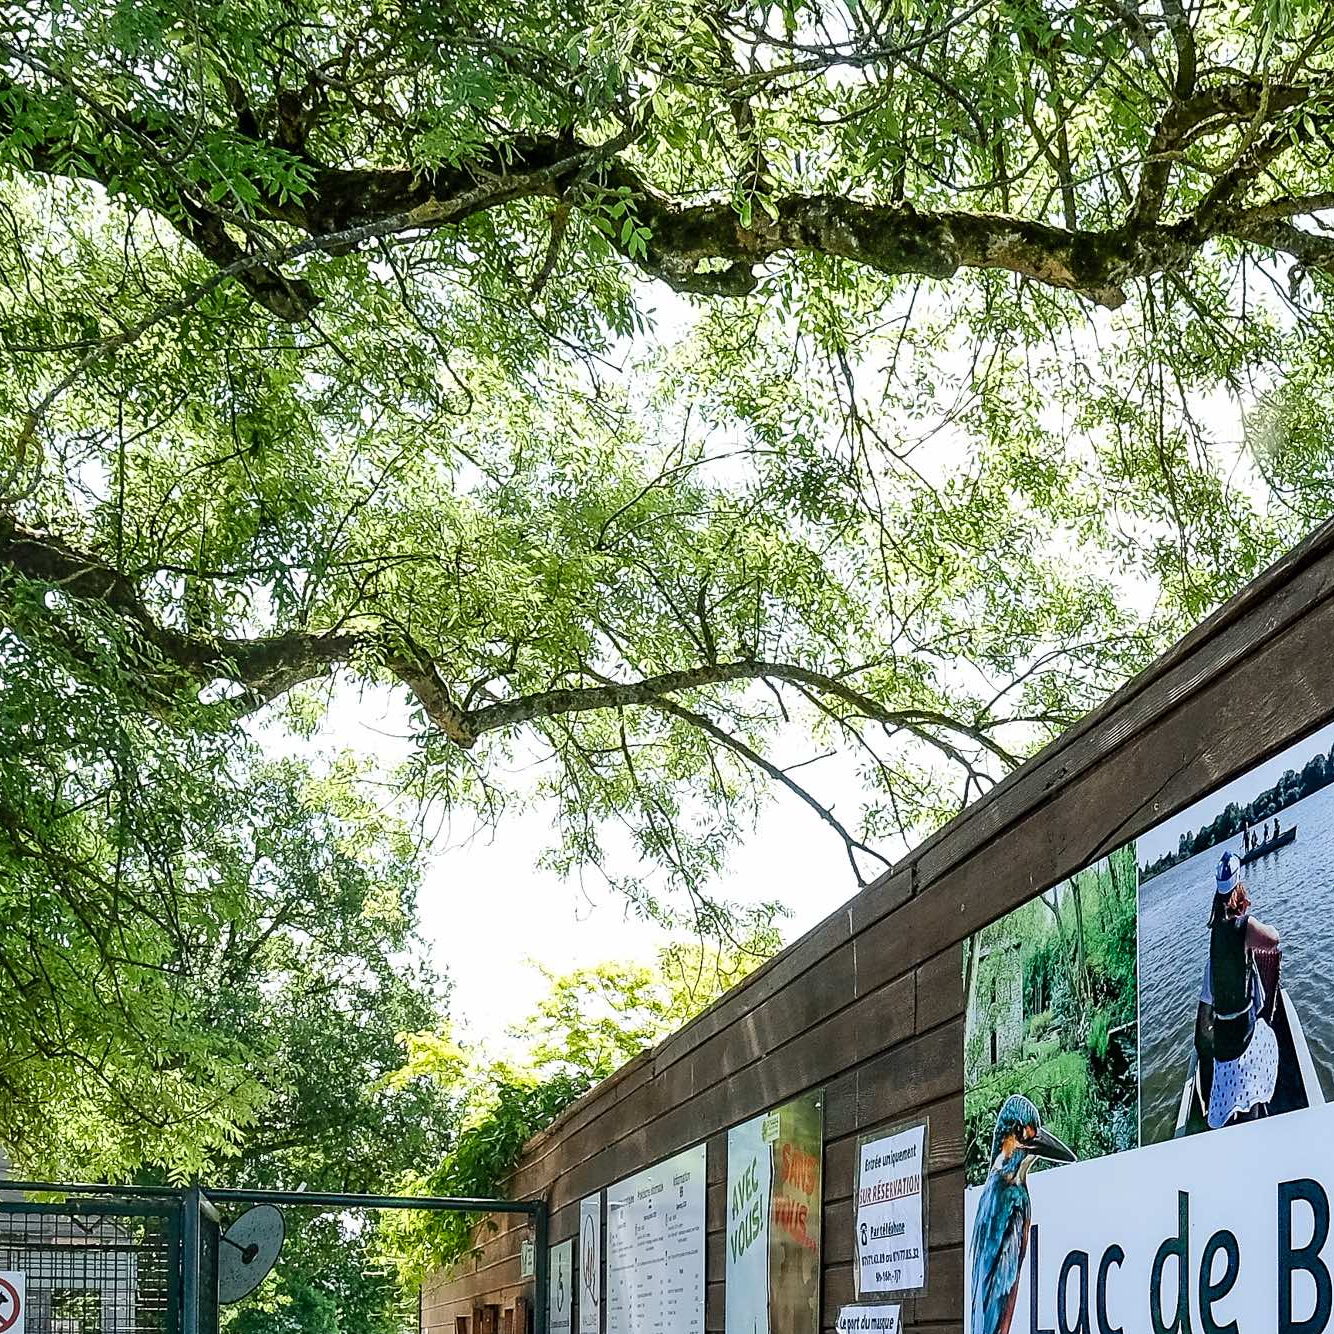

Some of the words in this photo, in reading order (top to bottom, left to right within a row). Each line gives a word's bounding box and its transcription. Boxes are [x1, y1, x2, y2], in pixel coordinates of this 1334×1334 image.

[882, 1145, 917, 1169] uniquement
[731, 1155, 760, 1221] AVEC
[859, 1187, 871, 1204] SUR
[872, 1174, 920, 1202] RÉSERVATION
[730, 1193, 764, 1265] VOUS!
[840, 1316, 847, 1330] Le
[847, 1317, 860, 1334] port
[860, 1314, 870, 1330] du
[871, 1317, 894, 1334] masque
